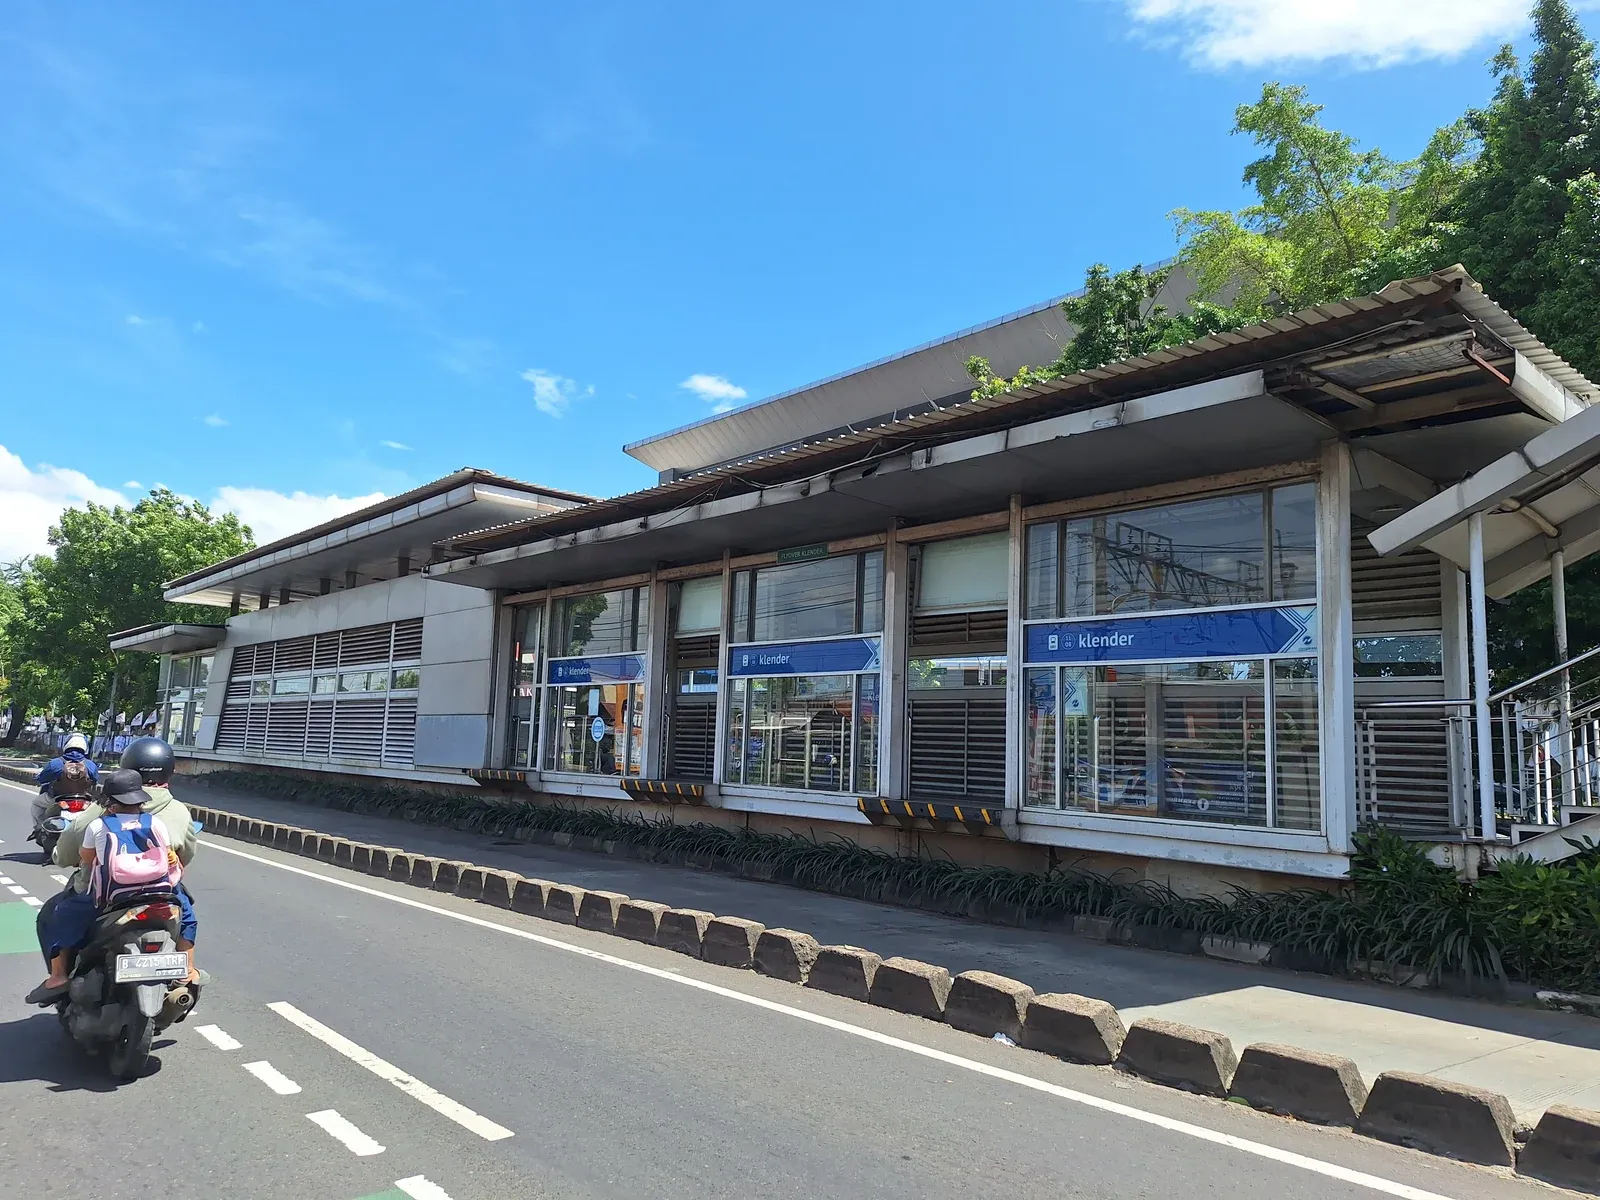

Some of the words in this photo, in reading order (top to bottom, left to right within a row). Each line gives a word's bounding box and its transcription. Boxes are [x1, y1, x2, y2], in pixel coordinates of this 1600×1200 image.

[802, 548, 824, 557] KLENDER
[1078, 631, 1135, 648] klender
[759, 653, 790, 665] klender
[569, 666, 589, 676] klender
[122, 959, 129, 969] B
[164, 954, 185, 966] TRF
